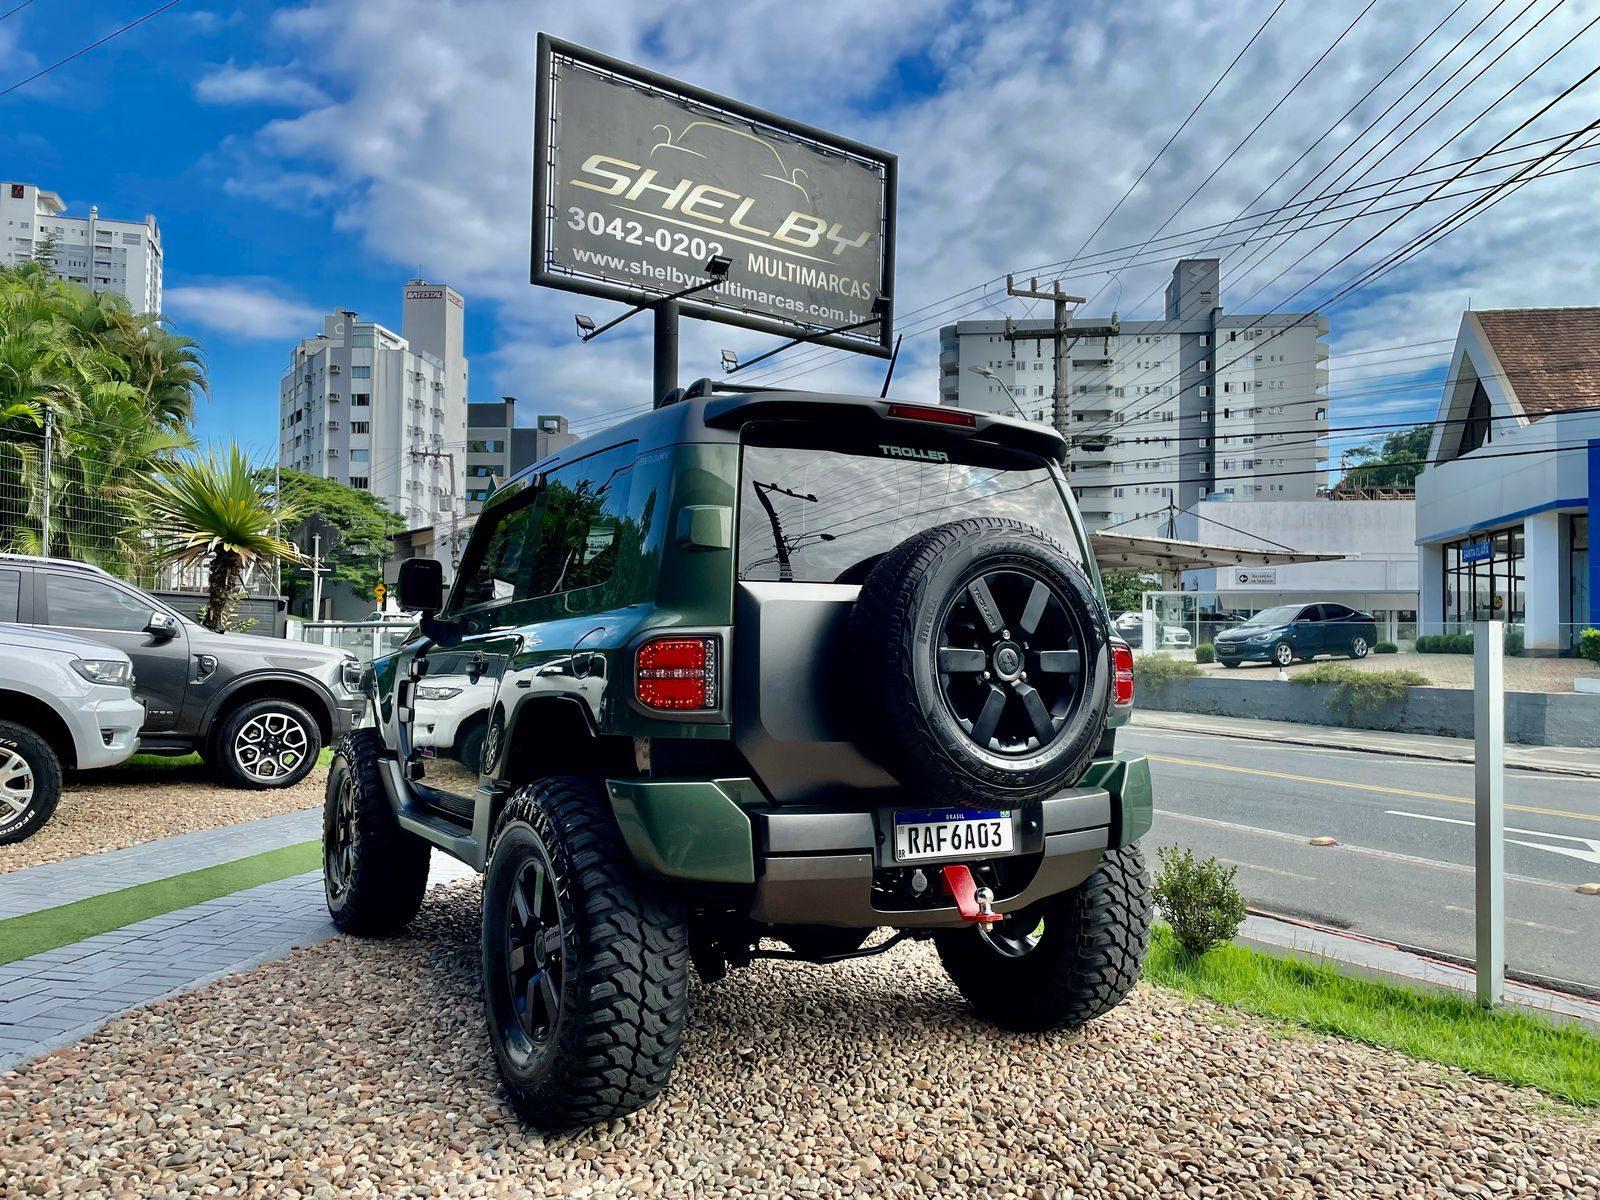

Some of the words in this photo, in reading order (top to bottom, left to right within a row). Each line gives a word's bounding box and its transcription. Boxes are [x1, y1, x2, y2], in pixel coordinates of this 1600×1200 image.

[568, 154, 871, 256] SHELBY
[567, 206, 724, 262] 3042-0202
[747, 252, 872, 300] MULTIMARCAS
[878, 444, 950, 462] TROLLER
[898, 849, 906, 858] BR
[908, 821, 1003, 855] RAF6A03
